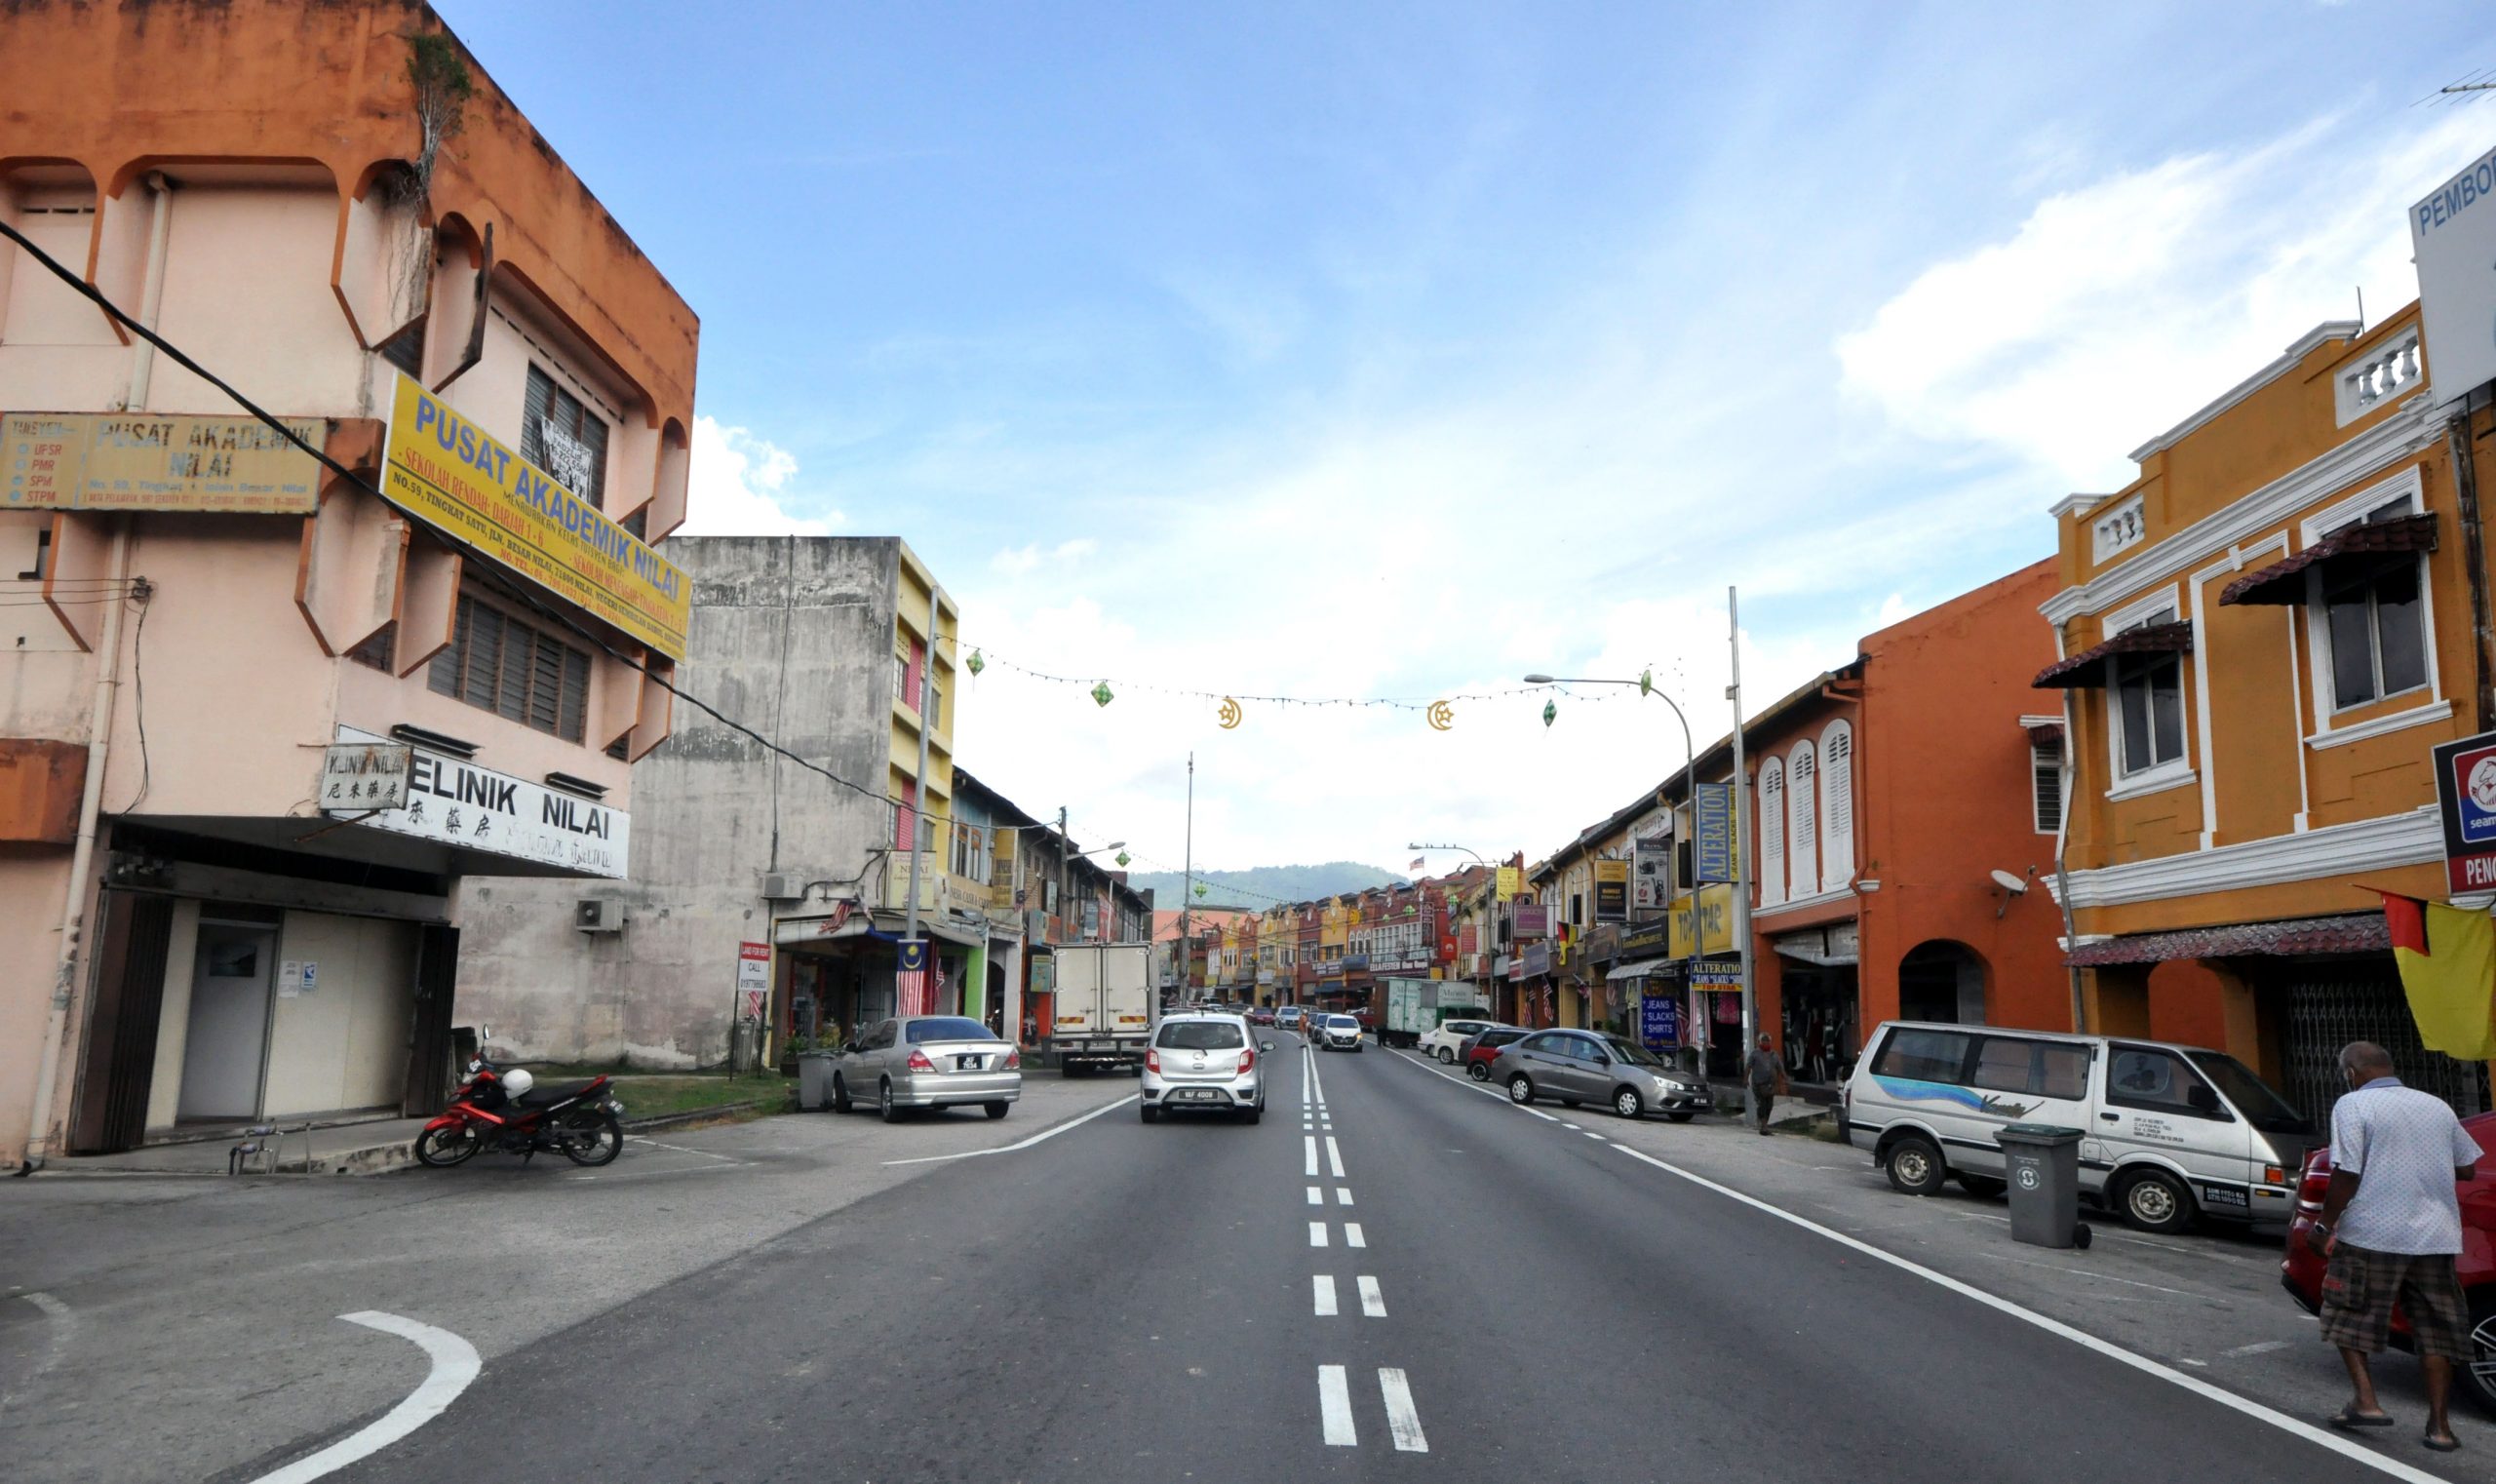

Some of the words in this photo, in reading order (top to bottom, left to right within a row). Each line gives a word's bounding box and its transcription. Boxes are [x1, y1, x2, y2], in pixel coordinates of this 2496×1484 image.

[31, 459, 56, 471] PMR
[29, 475, 53, 487] SPM
[27, 490, 57, 502] STPM
[406, 447, 450, 489] SEKOLAH
[452, 475, 490, 516] RENDAH:
[492, 501, 525, 537] DARJAH
[415, 394, 511, 486] PUSAT
[514, 467, 632, 568] AKADEMIK
[634, 545, 680, 602] NILAI
[503, 490, 557, 534] MENAWARKAN
[558, 526, 579, 548] KELAS
[426, 491, 465, 523] TINGKAT
[466, 513, 488, 537] SATU,
[507, 539, 531, 561] BESAR
[573, 554, 604, 582] SEKOLAH
[371, 755, 404, 775] NILAI
[409, 754, 518, 816] ELINIK
[542, 794, 609, 840] NILAI
[1700, 787, 1727, 879] ALTERATION
[900, 865, 929, 875] NIAI
[748, 962, 760, 972] CALL
[1693, 963, 1741, 974] ALTERATIO
[1647, 999, 1670, 1009] JEANS
[1648, 1012, 1675, 1021] SLACKS
[1648, 1024, 1673, 1034] SHIRTS
